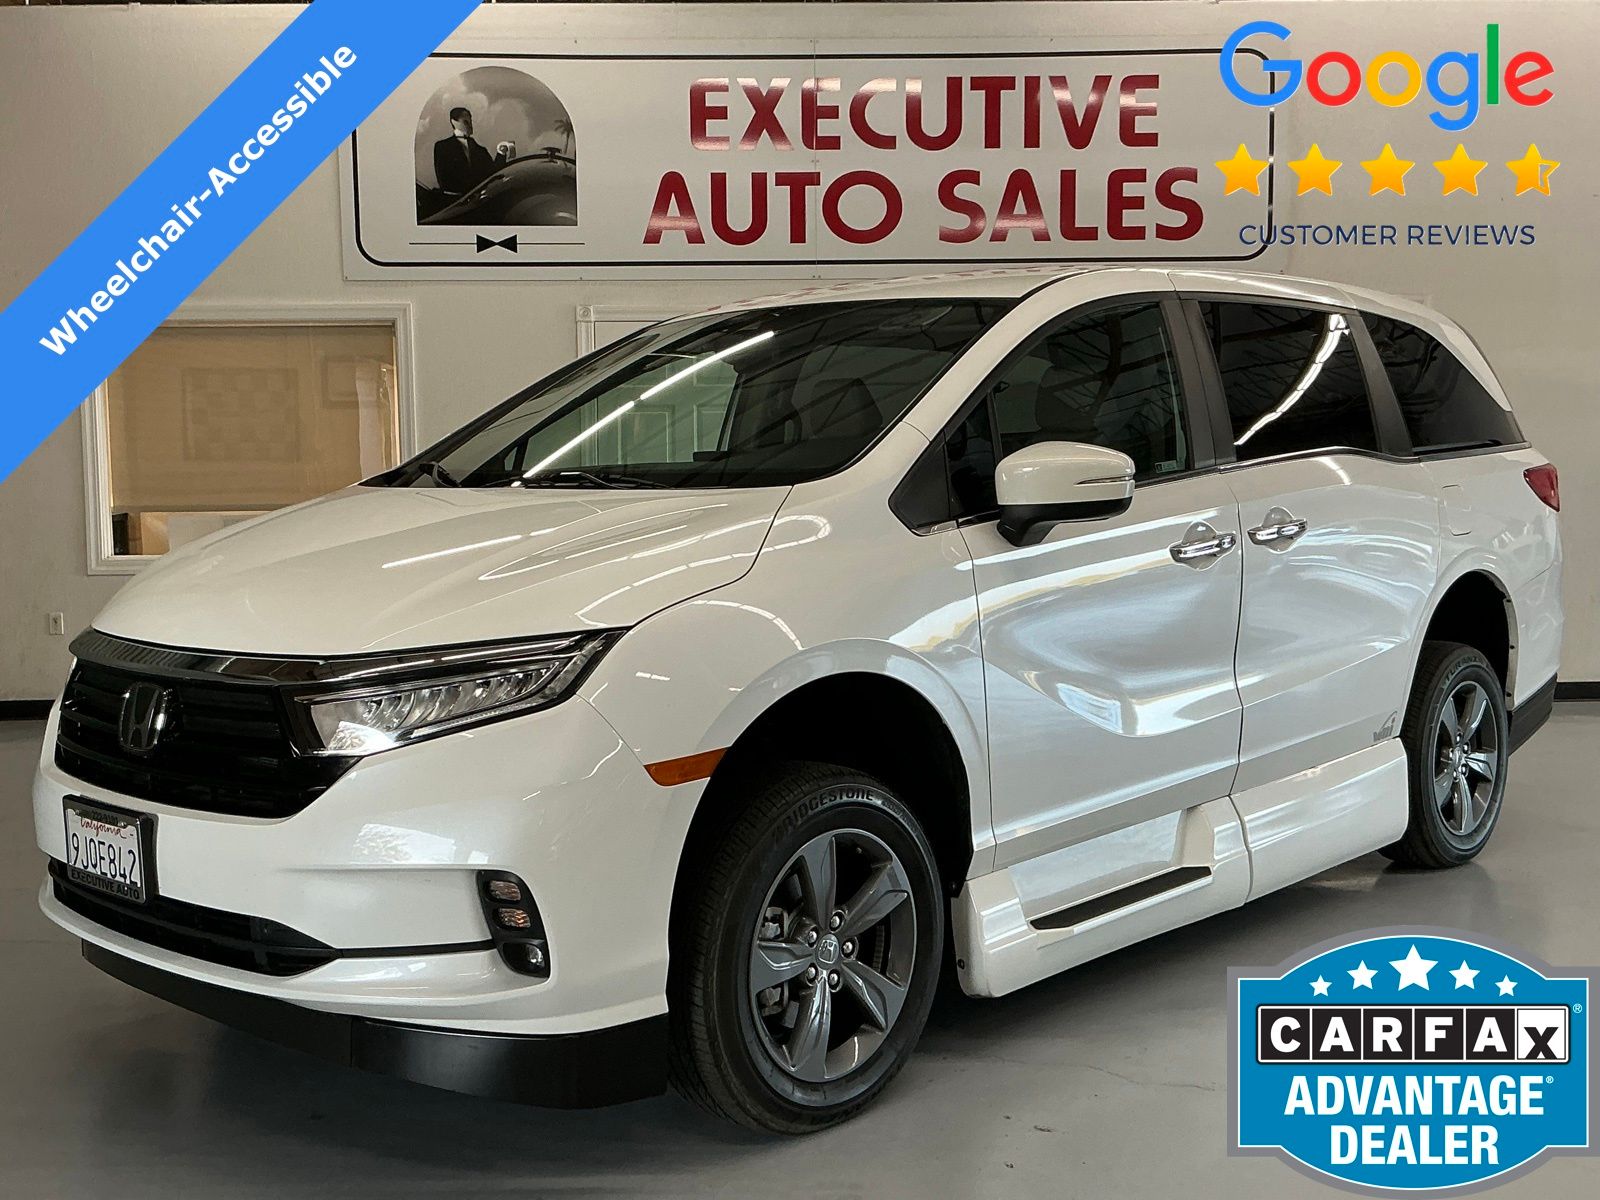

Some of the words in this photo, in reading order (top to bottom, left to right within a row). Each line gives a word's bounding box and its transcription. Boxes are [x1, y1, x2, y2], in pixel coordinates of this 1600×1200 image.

[688, 73, 1160, 152] EXECUTIVE
[642, 169, 903, 245] AUTO
[936, 166, 1204, 244] SALES
[71, 868, 116, 893] EXECUTIVE
